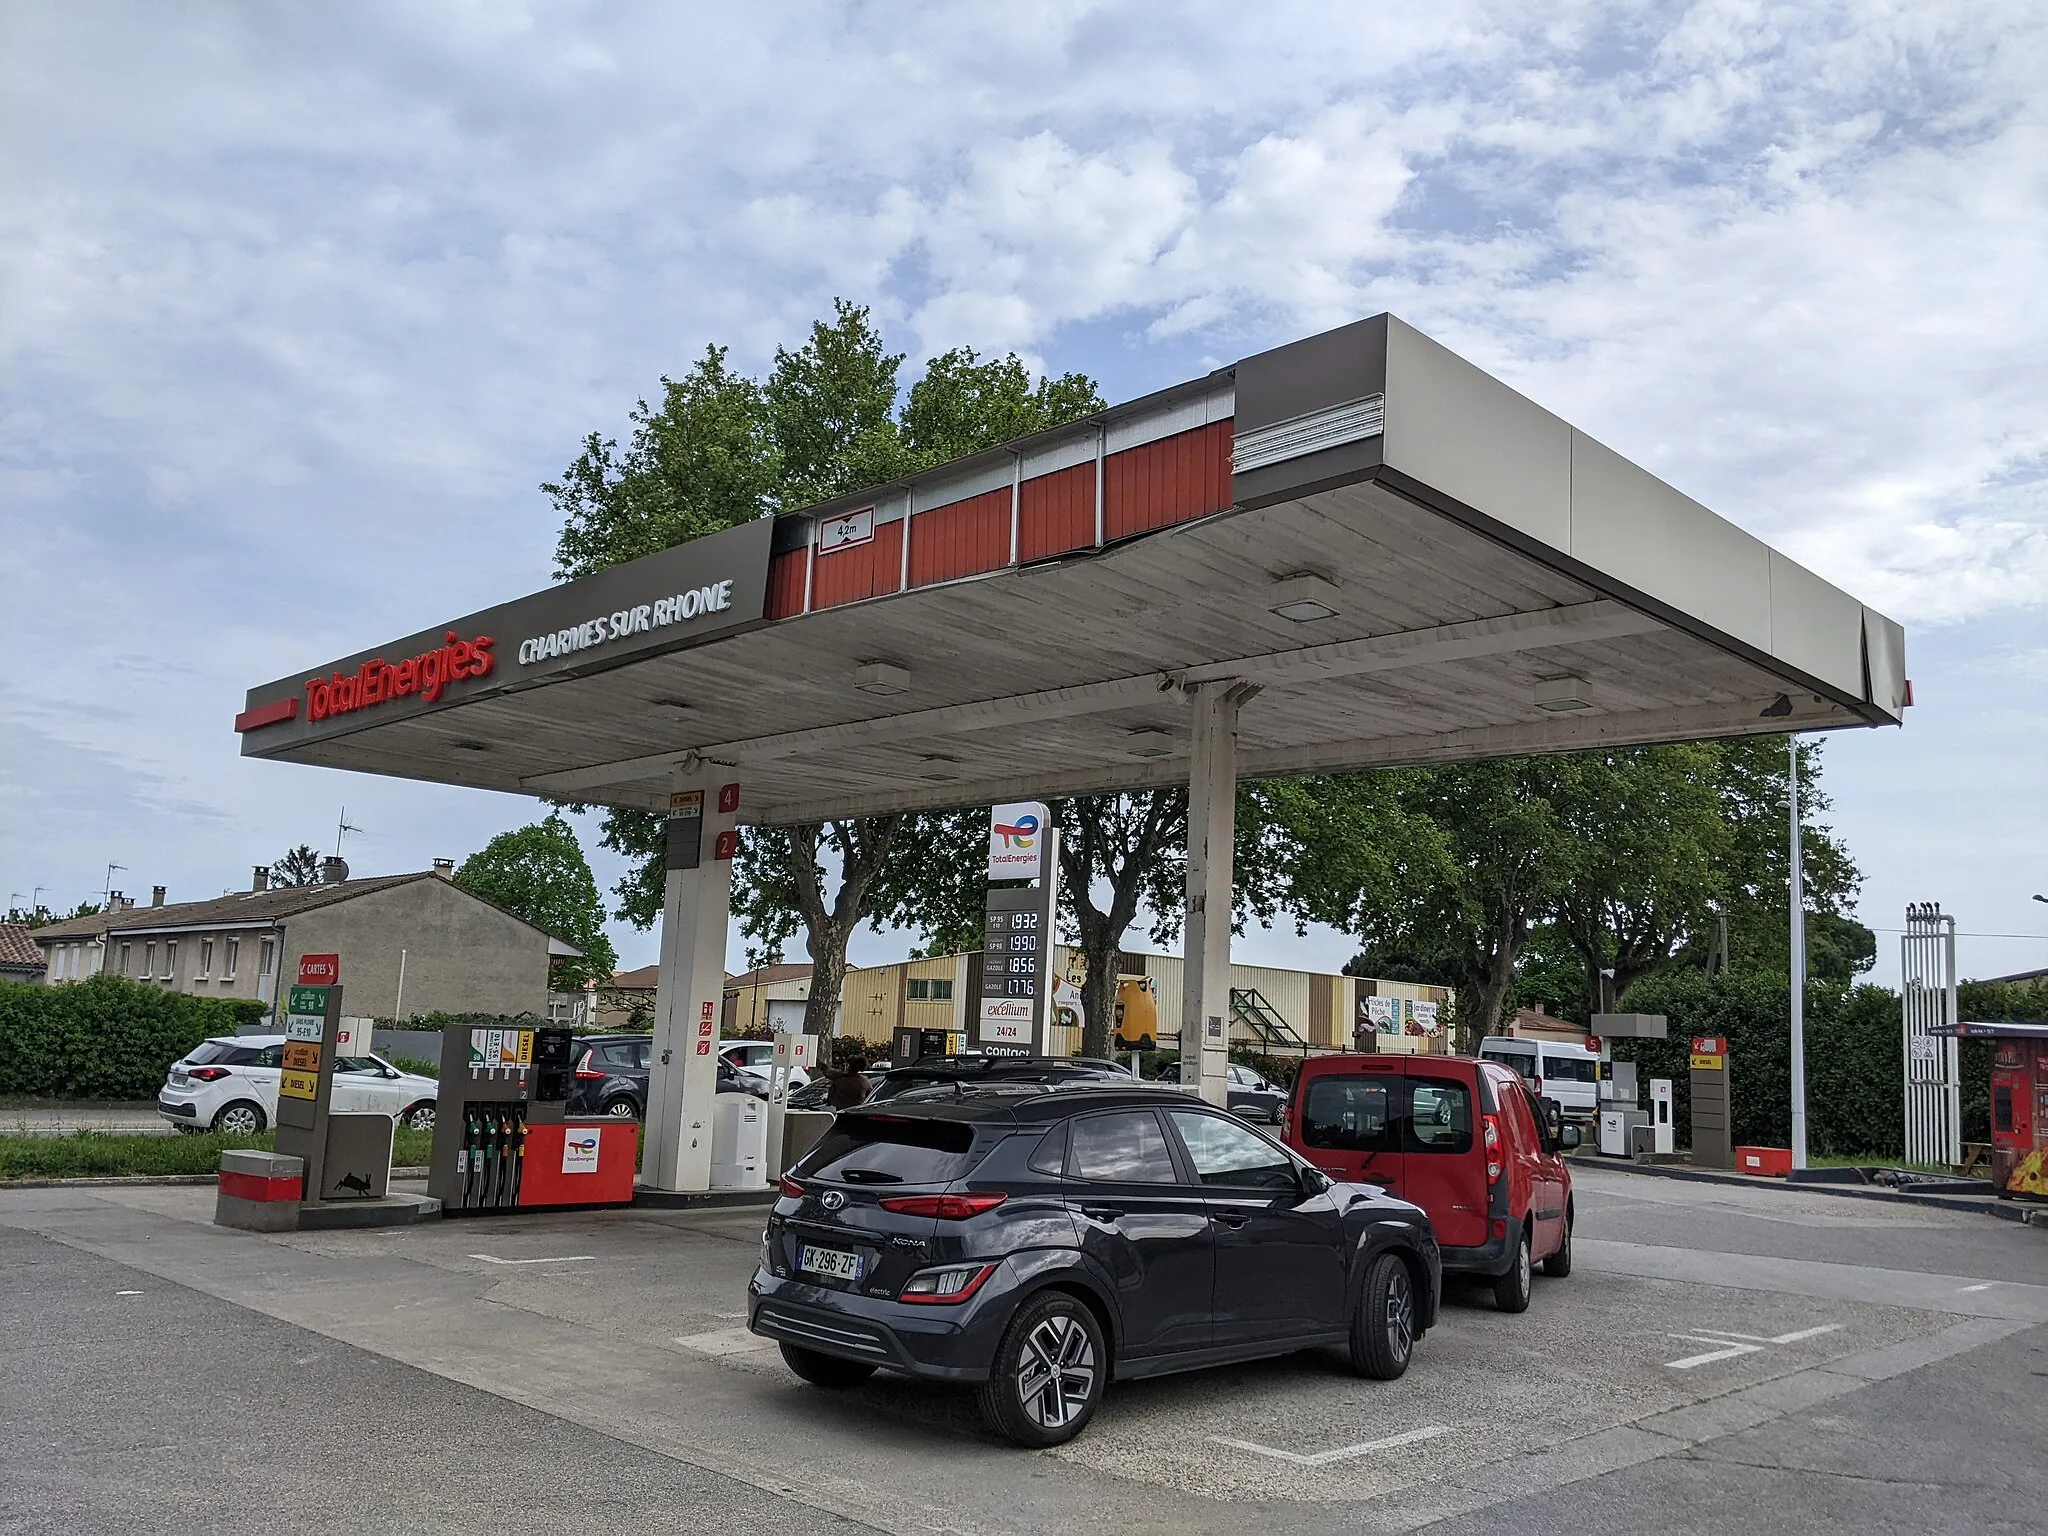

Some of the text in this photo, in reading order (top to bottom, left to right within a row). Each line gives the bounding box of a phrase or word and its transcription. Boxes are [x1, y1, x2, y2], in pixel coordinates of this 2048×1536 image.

[837, 524, 857, 538] 4,2m
[518, 579, 733, 666] CHARMES SUR RHONE
[304, 630, 494, 724] TotalEnergies
[724, 789, 732, 806] 4
[720, 836, 729, 855] 2
[992, 852, 1038, 865] TotalEnergies
[307, 963, 326, 975] CARTES
[986, 964, 1003, 972] GAZOLE
[987, 1001, 1029, 1017] excellium
[996, 1026, 1017, 1037] 24/24
[521, 1033, 530, 1060] DIESEL
[1590, 1040, 1597, 1050] 5
[290, 1079, 305, 1089] DIESEL
[521, 1090, 527, 1099] 2
[892, 1237, 926, 1247] KONA
[869, 1286, 891, 1296] electric
